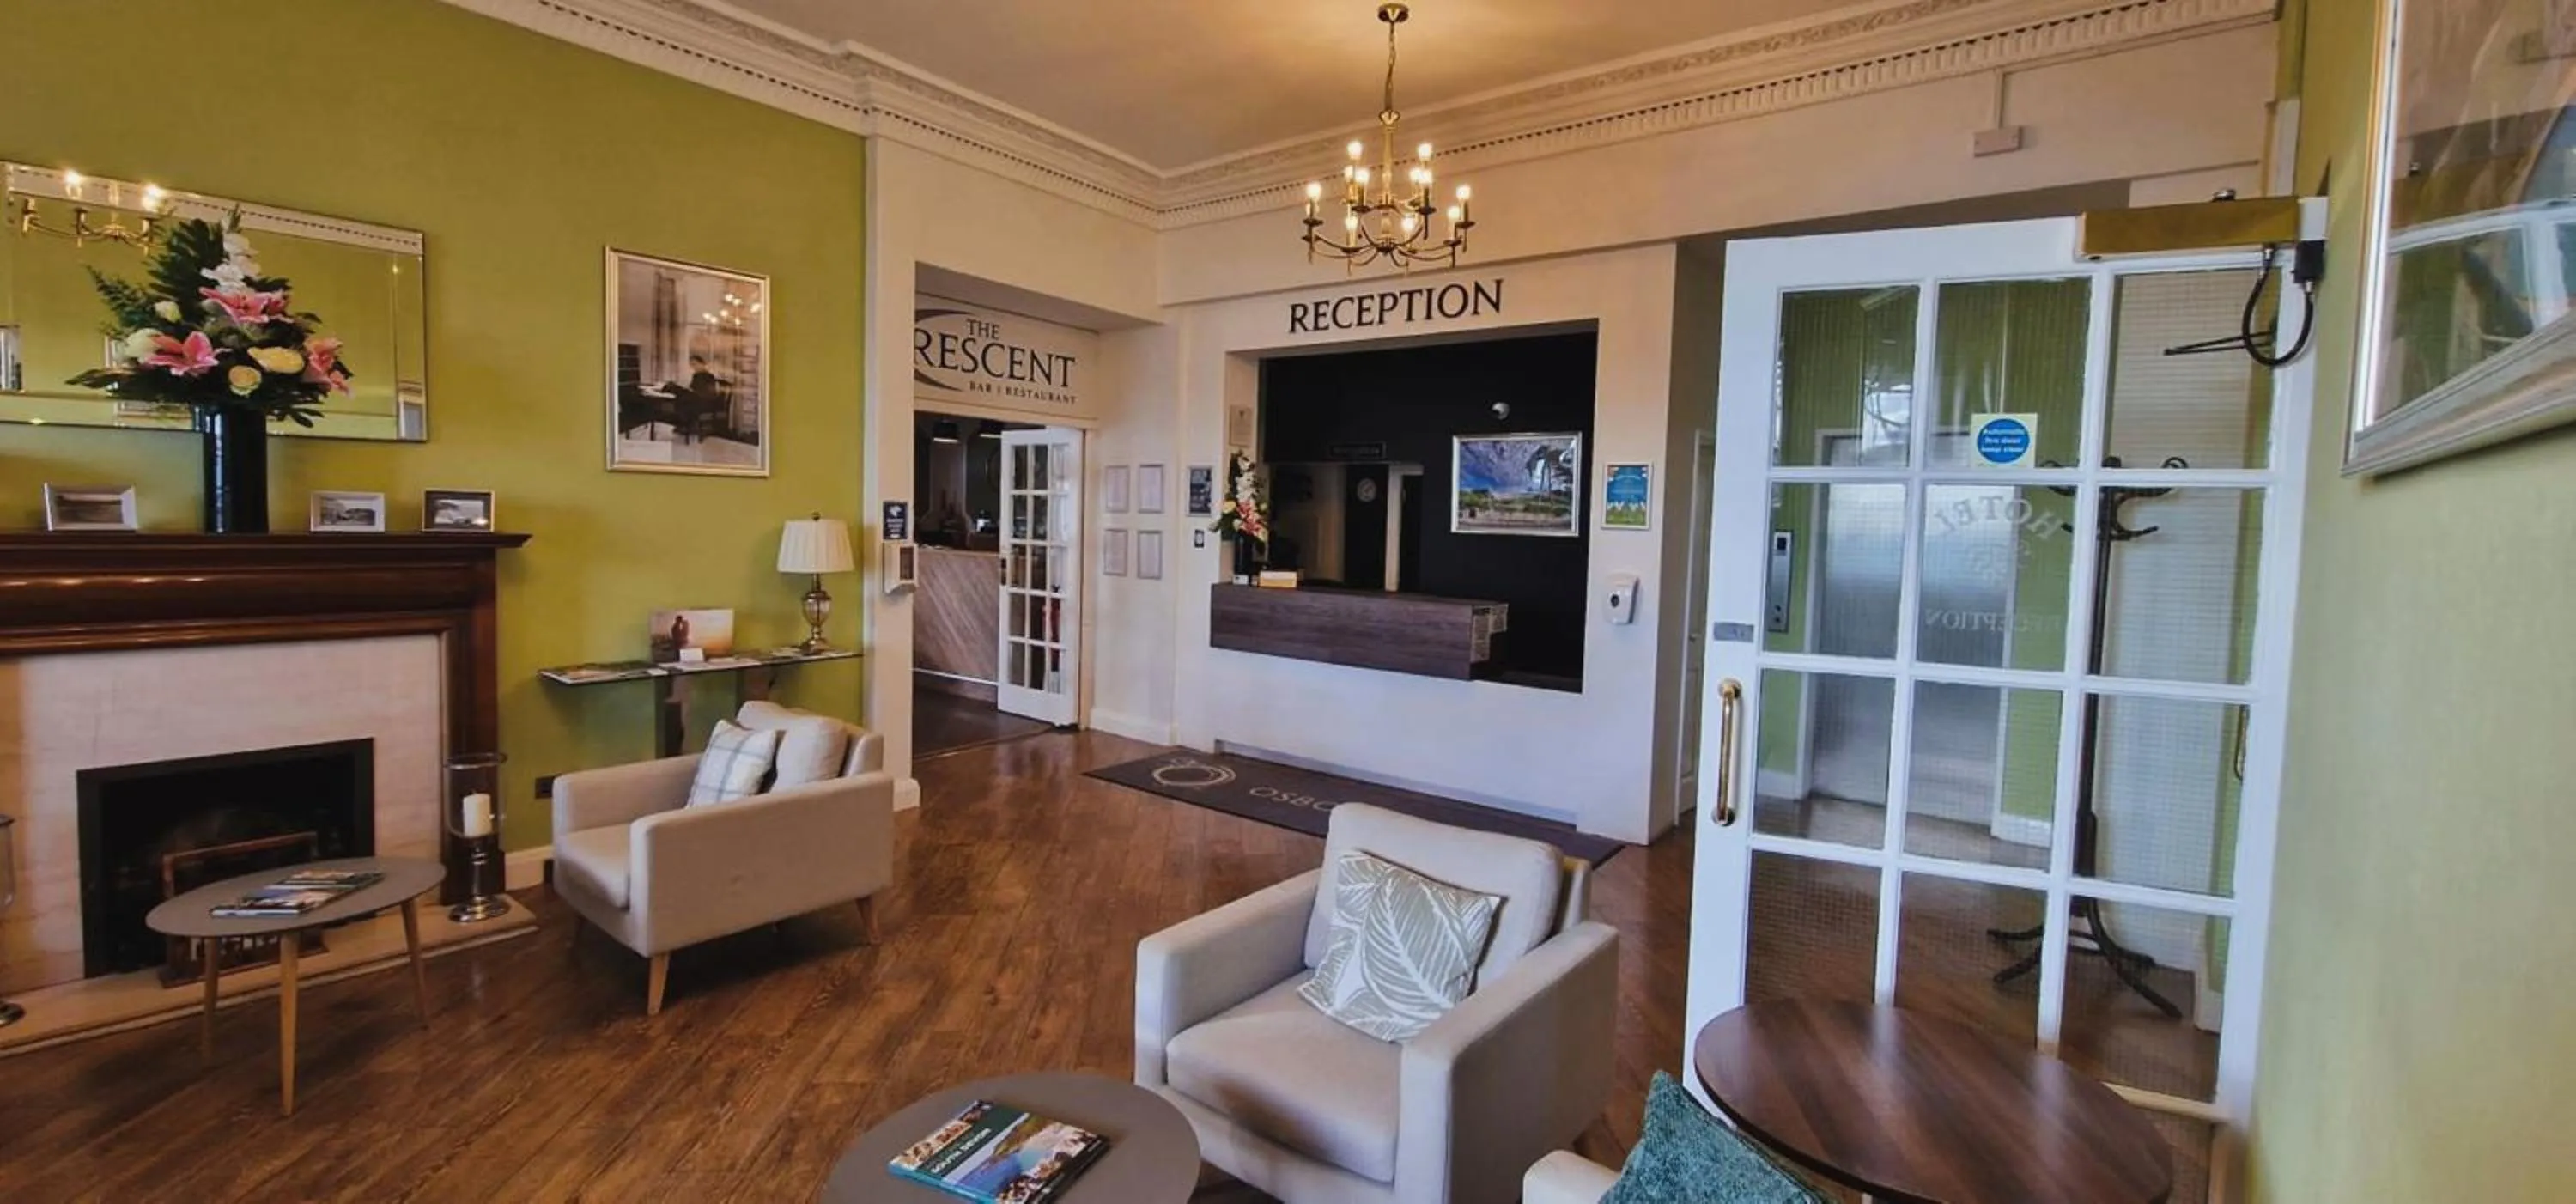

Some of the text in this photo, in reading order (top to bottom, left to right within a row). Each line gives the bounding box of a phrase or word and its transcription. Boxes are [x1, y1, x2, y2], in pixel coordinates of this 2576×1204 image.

[1289, 278, 1504, 334] RECEPTION
[966, 319, 1000, 340] THE
[969, 380, 1077, 404] BAR RESTAURANT
